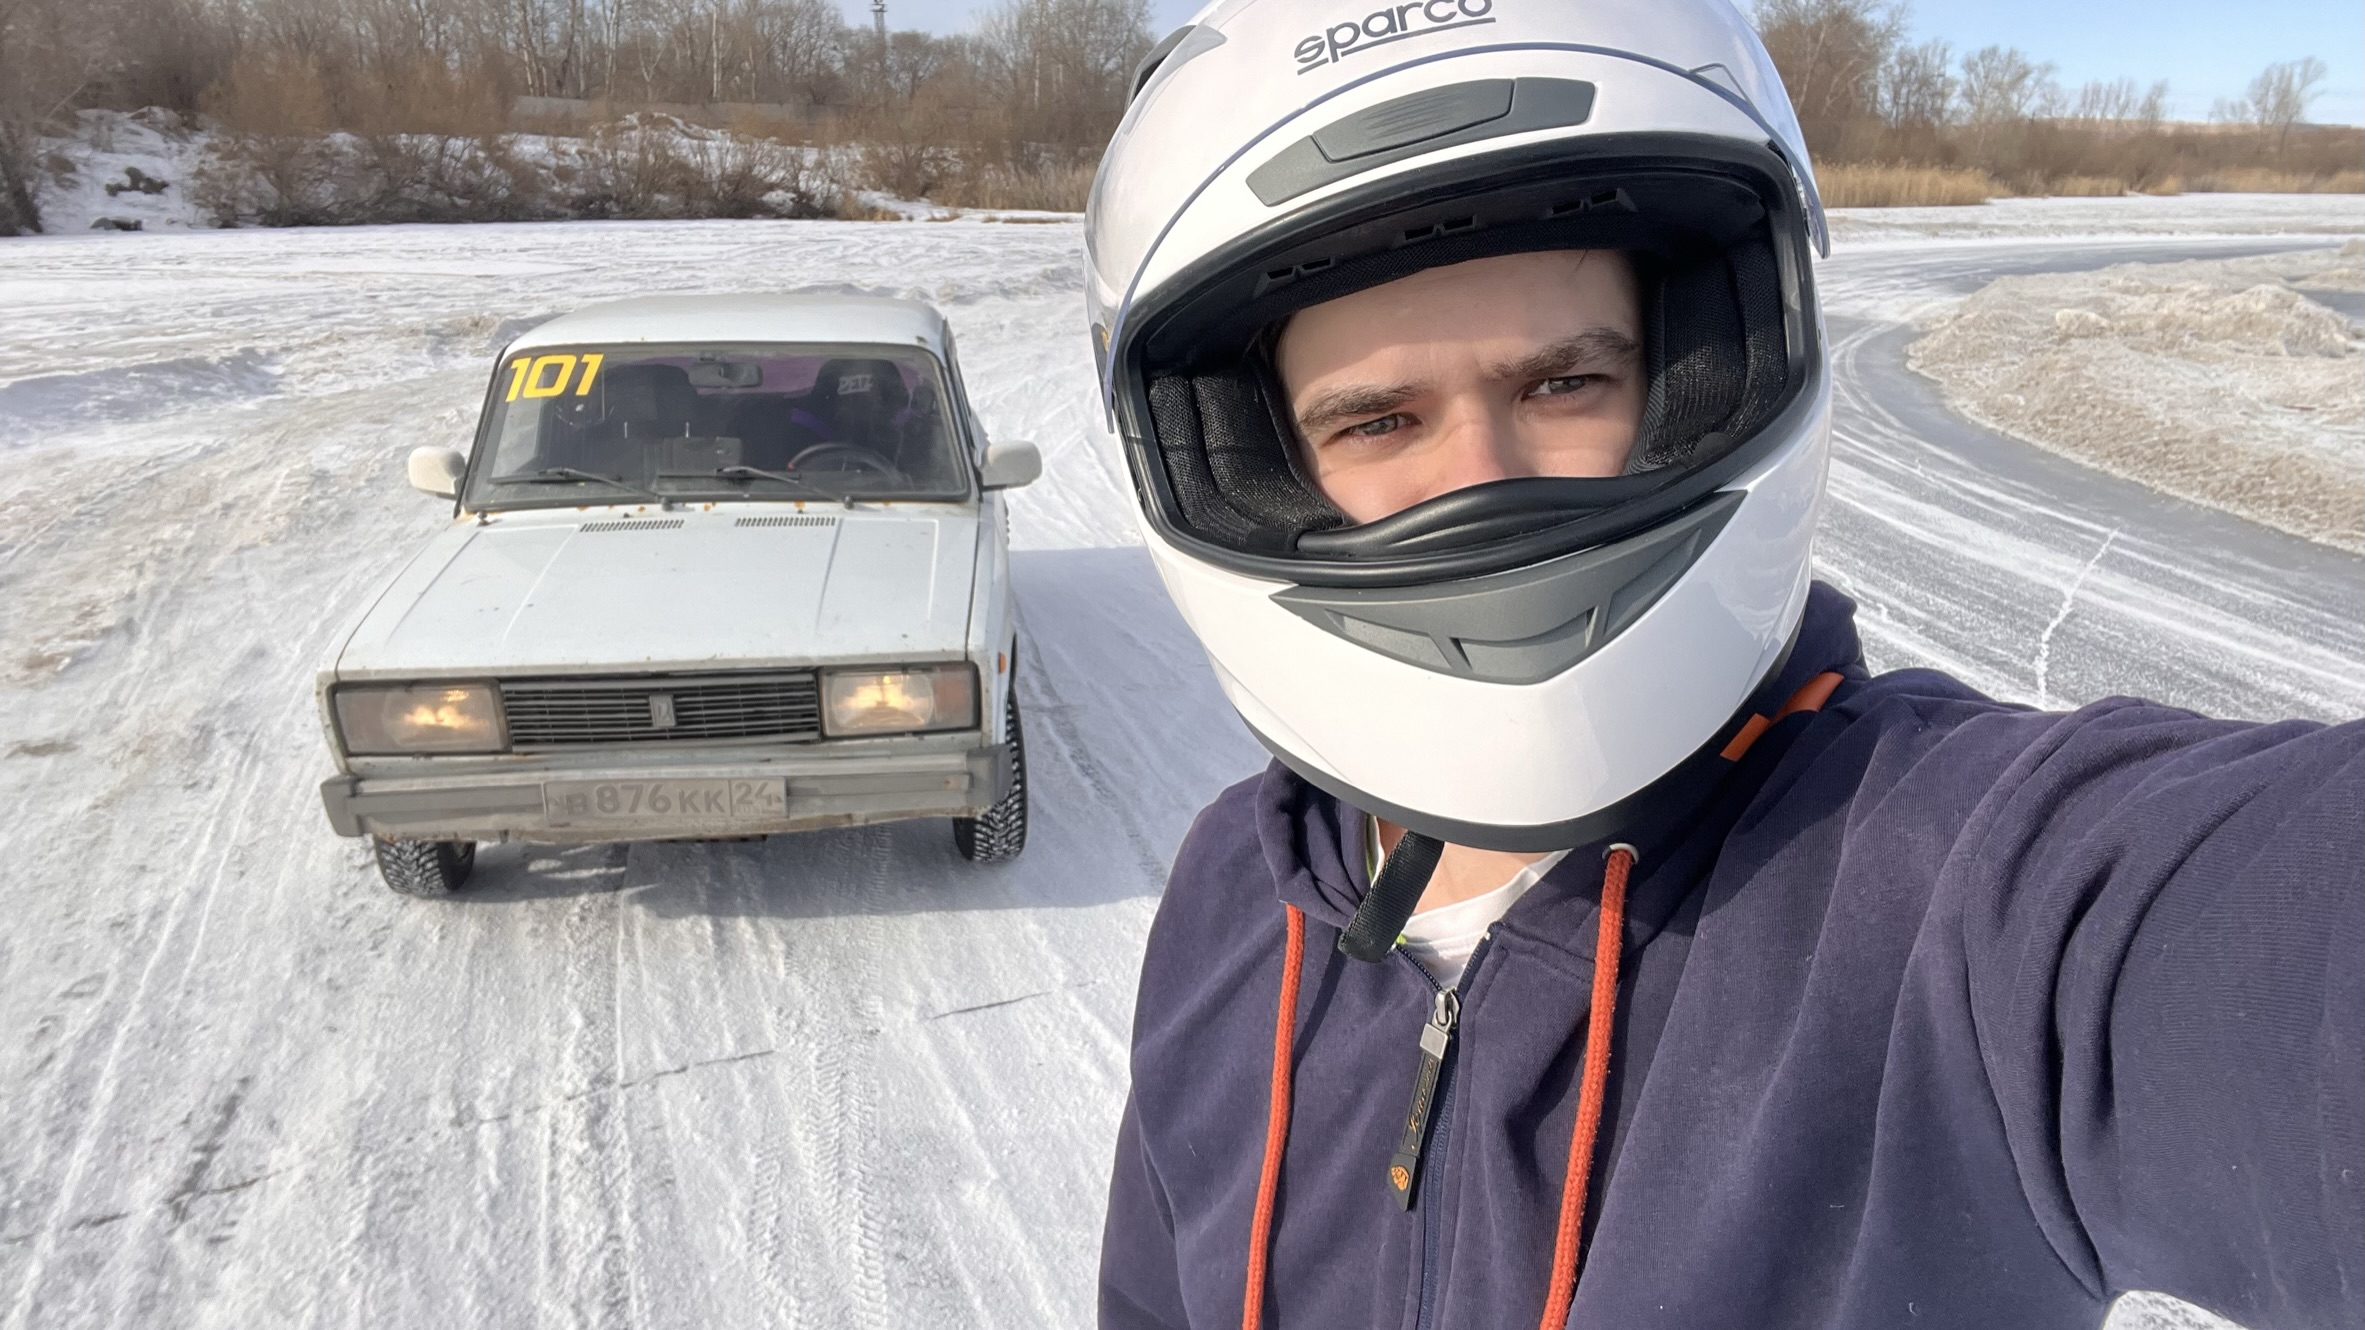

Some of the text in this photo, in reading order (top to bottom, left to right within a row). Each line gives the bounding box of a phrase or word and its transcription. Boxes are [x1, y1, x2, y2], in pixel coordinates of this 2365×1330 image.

[1294, 0, 1494, 64] sparco
[505, 353, 604, 402] 101
[734, 781, 773, 807] 24
